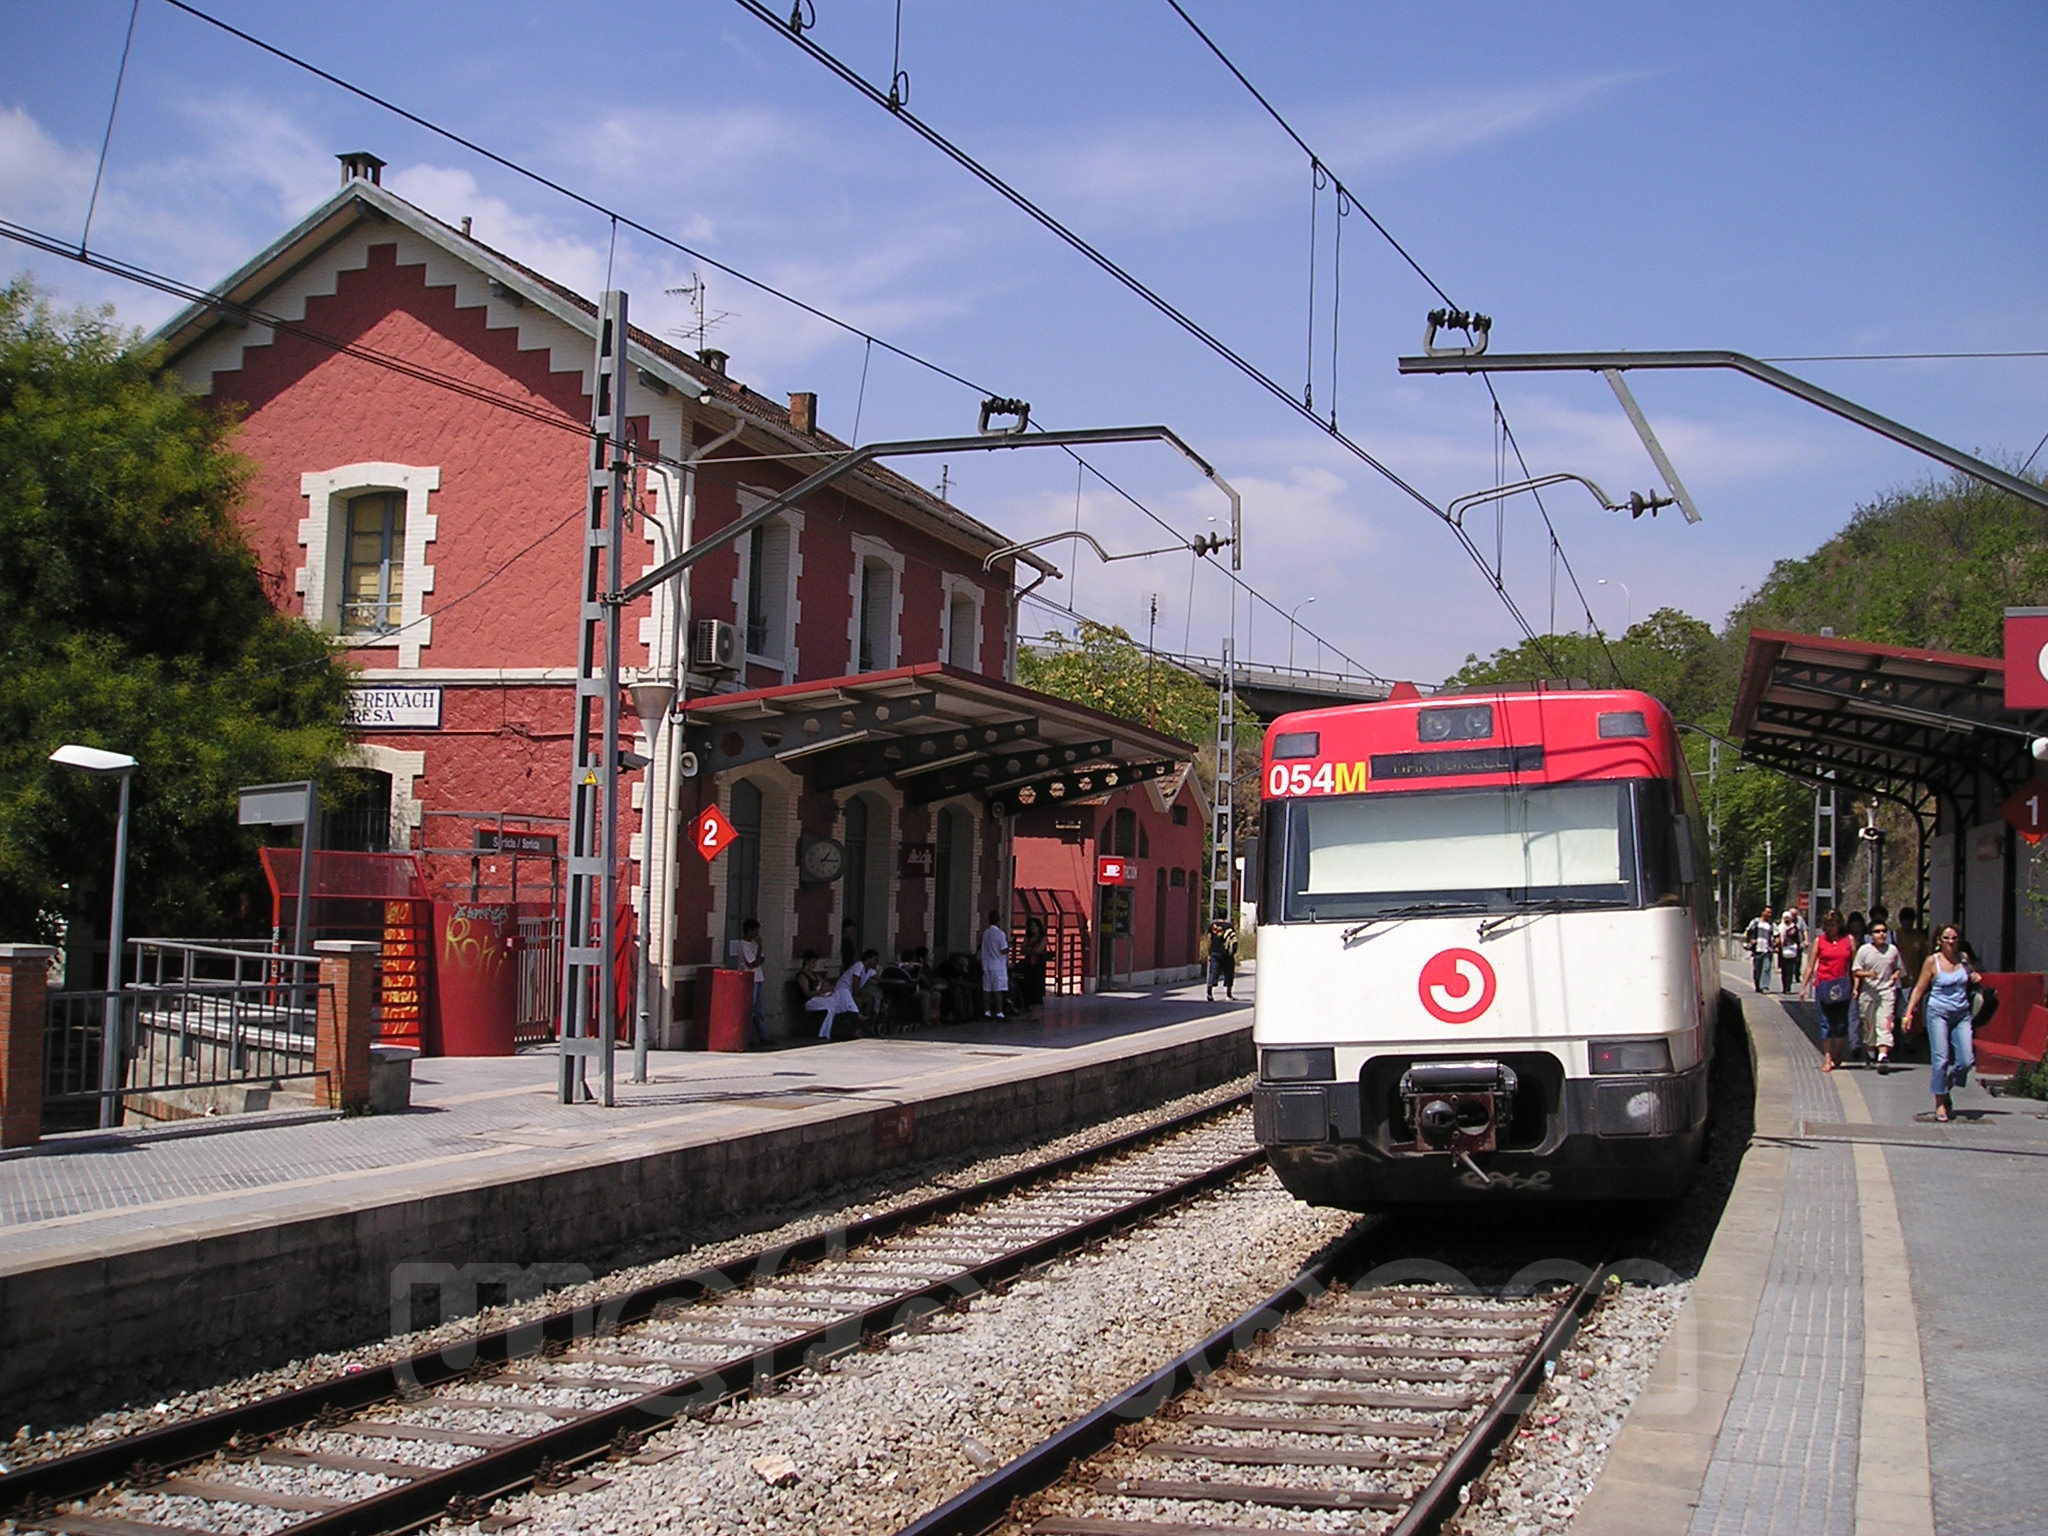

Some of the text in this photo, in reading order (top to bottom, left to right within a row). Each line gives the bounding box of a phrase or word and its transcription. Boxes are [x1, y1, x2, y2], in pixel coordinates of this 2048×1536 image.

[1269, 762, 1366, 796] 054M
[2026, 796, 2039, 826] 1
[703, 819, 718, 846] 2
